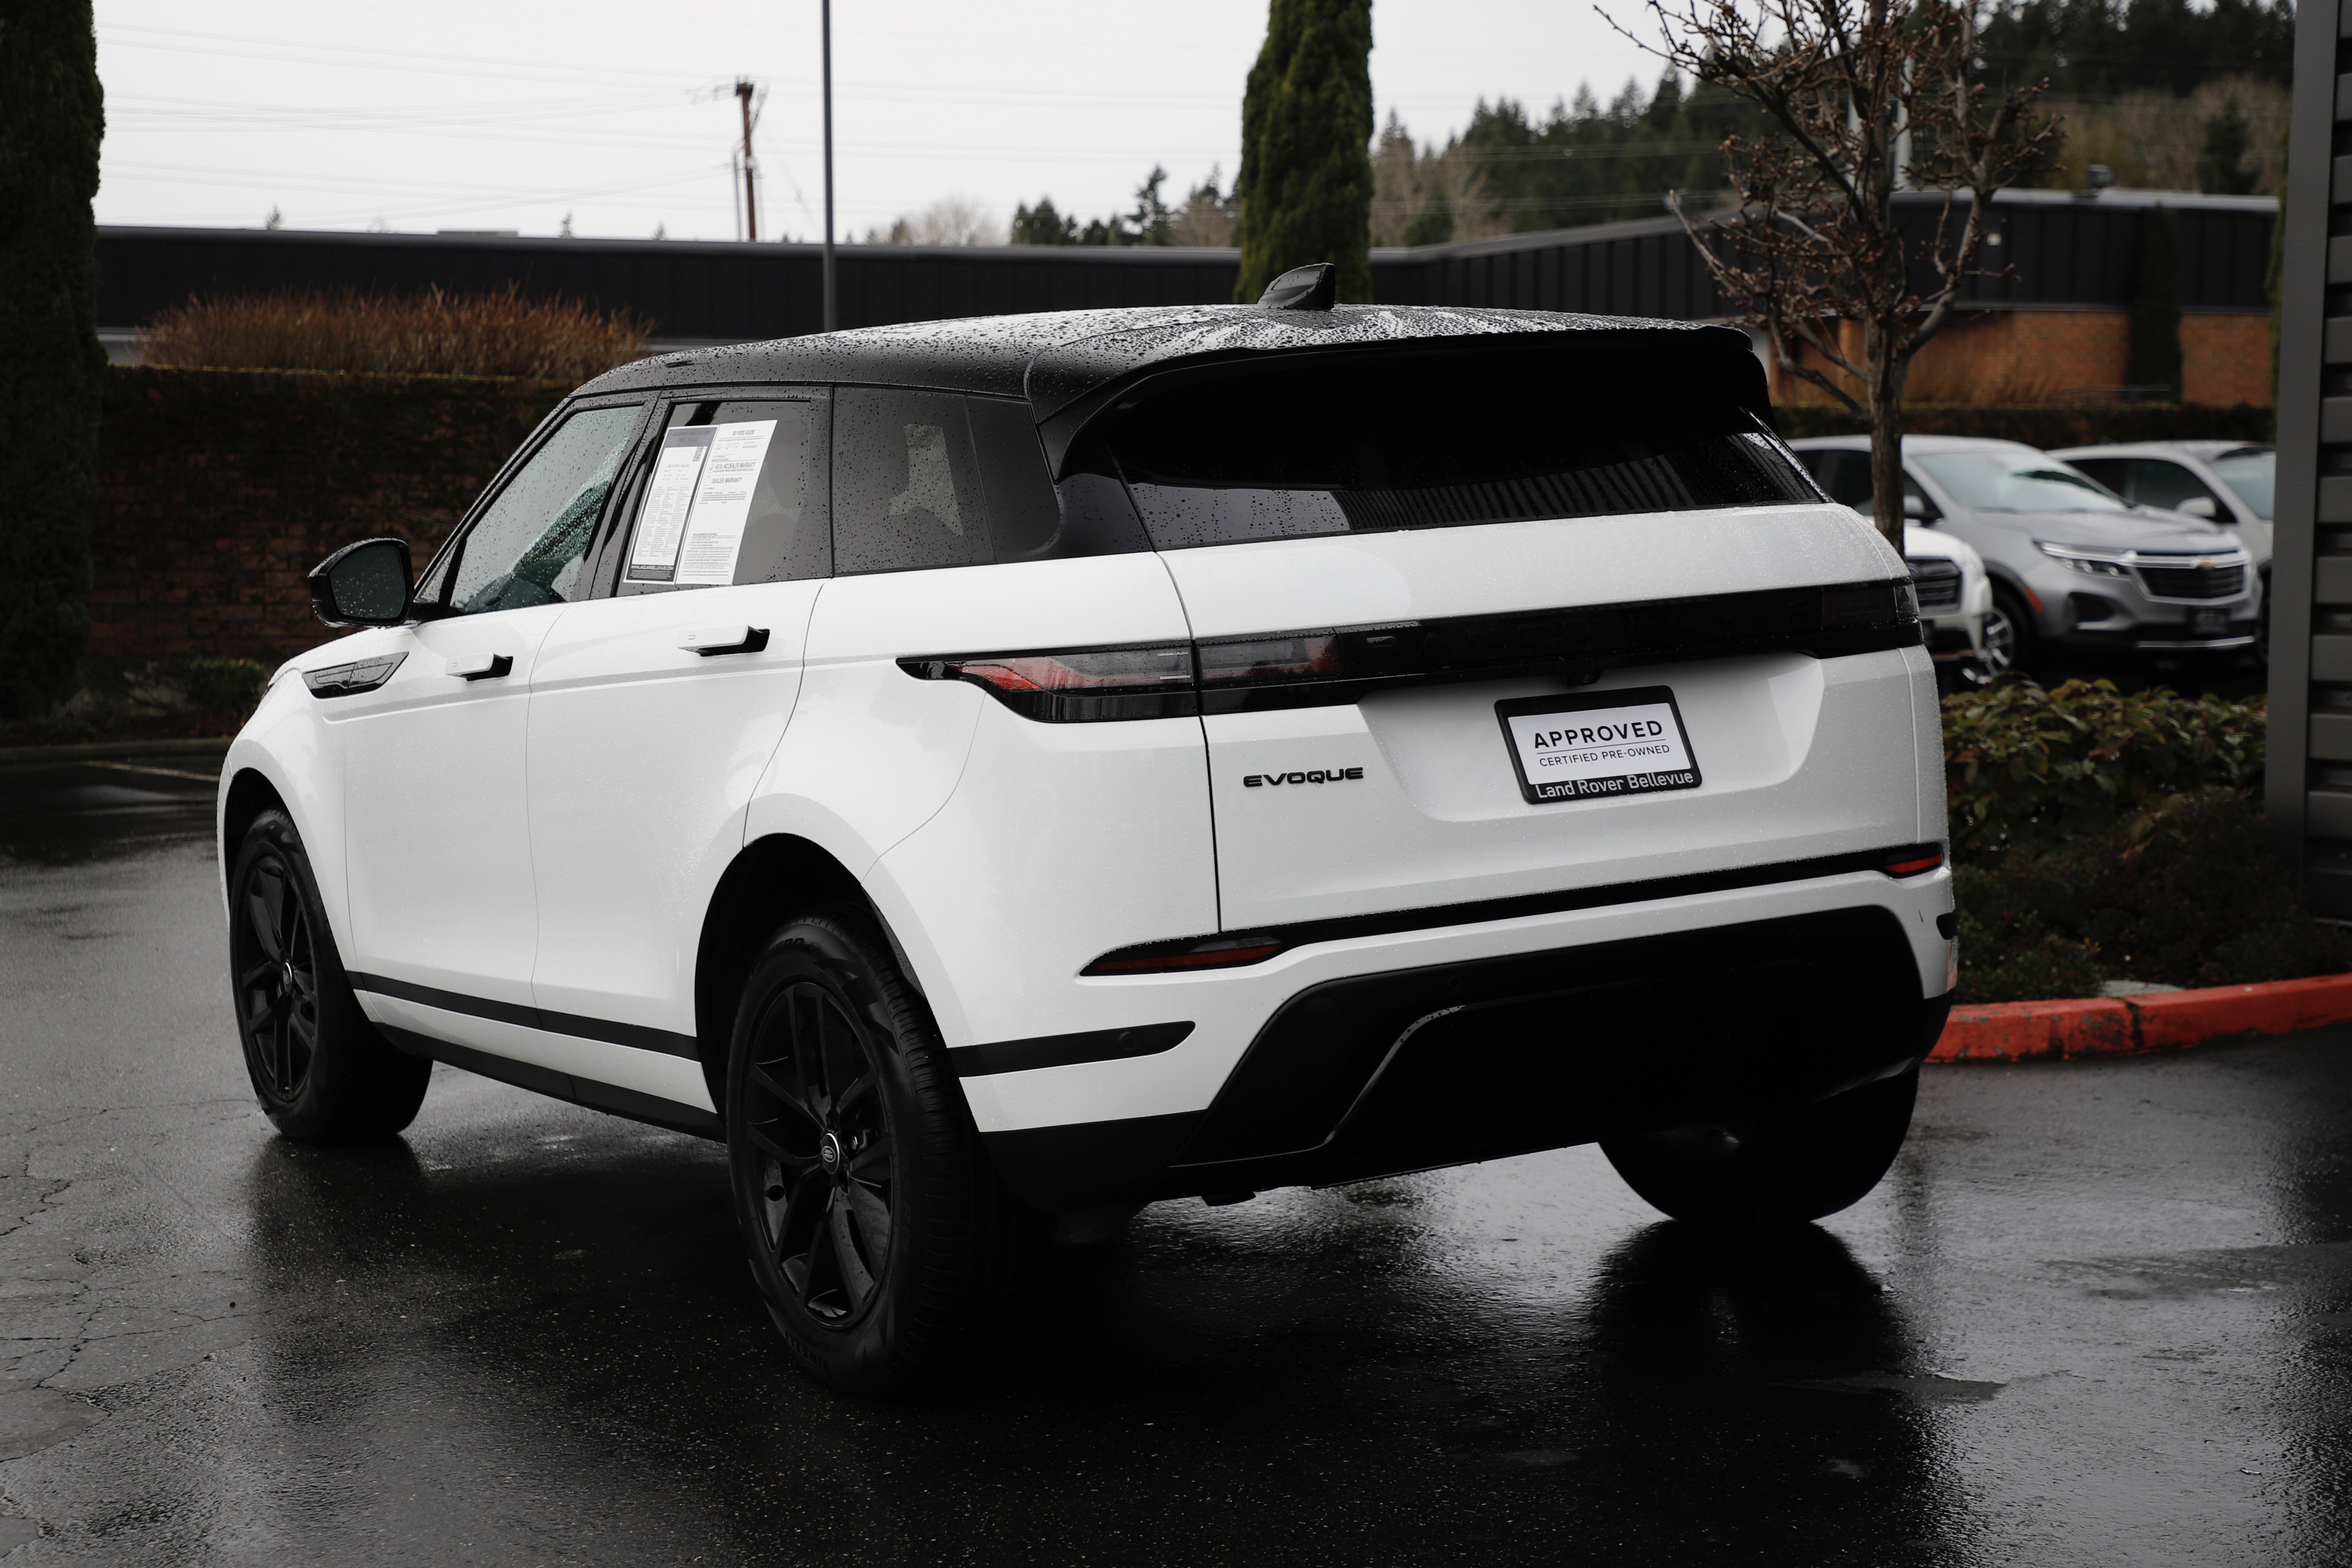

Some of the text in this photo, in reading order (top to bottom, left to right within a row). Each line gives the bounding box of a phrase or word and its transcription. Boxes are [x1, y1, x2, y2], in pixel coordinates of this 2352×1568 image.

[1534, 720, 1662, 748] APPROVED
[1539, 744, 1670, 767] CERTIFIED PRE-OWNED
[1243, 767, 1363, 787] EVOQUE
[1536, 772, 1694, 798] Land Rover Bellevue
